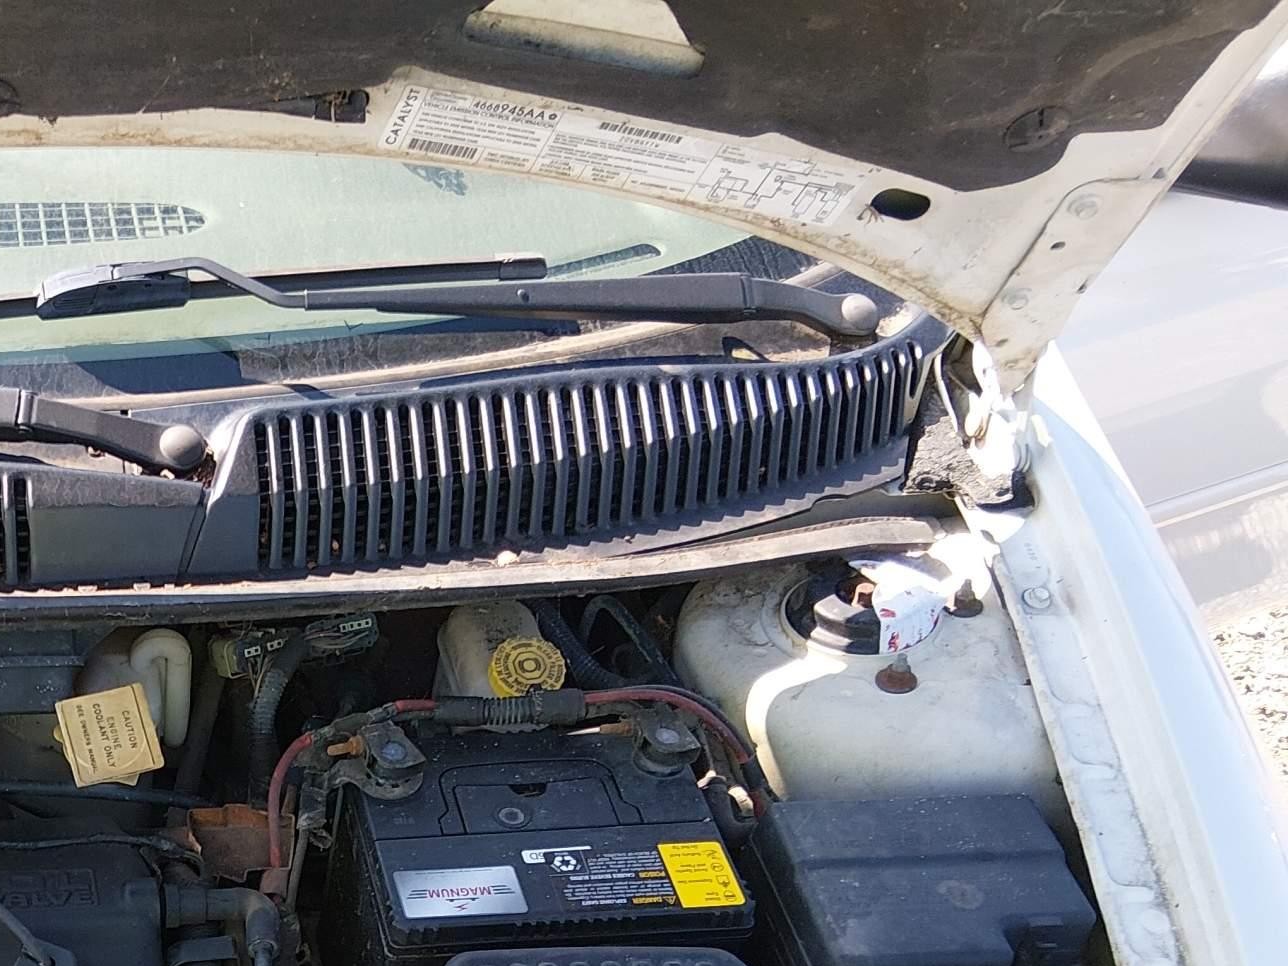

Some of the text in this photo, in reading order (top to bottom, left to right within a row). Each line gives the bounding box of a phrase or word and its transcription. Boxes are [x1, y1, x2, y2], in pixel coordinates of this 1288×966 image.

[385, 88, 421, 145] CATALYST
[92, 703, 117, 768] COOLANT ONLY
[106, 716, 122, 750] ENGINE
[121, 710, 139, 749] CAUTION
[425, 885, 493, 899] MAGNUM
[632, 896, 663, 904] DANGER
